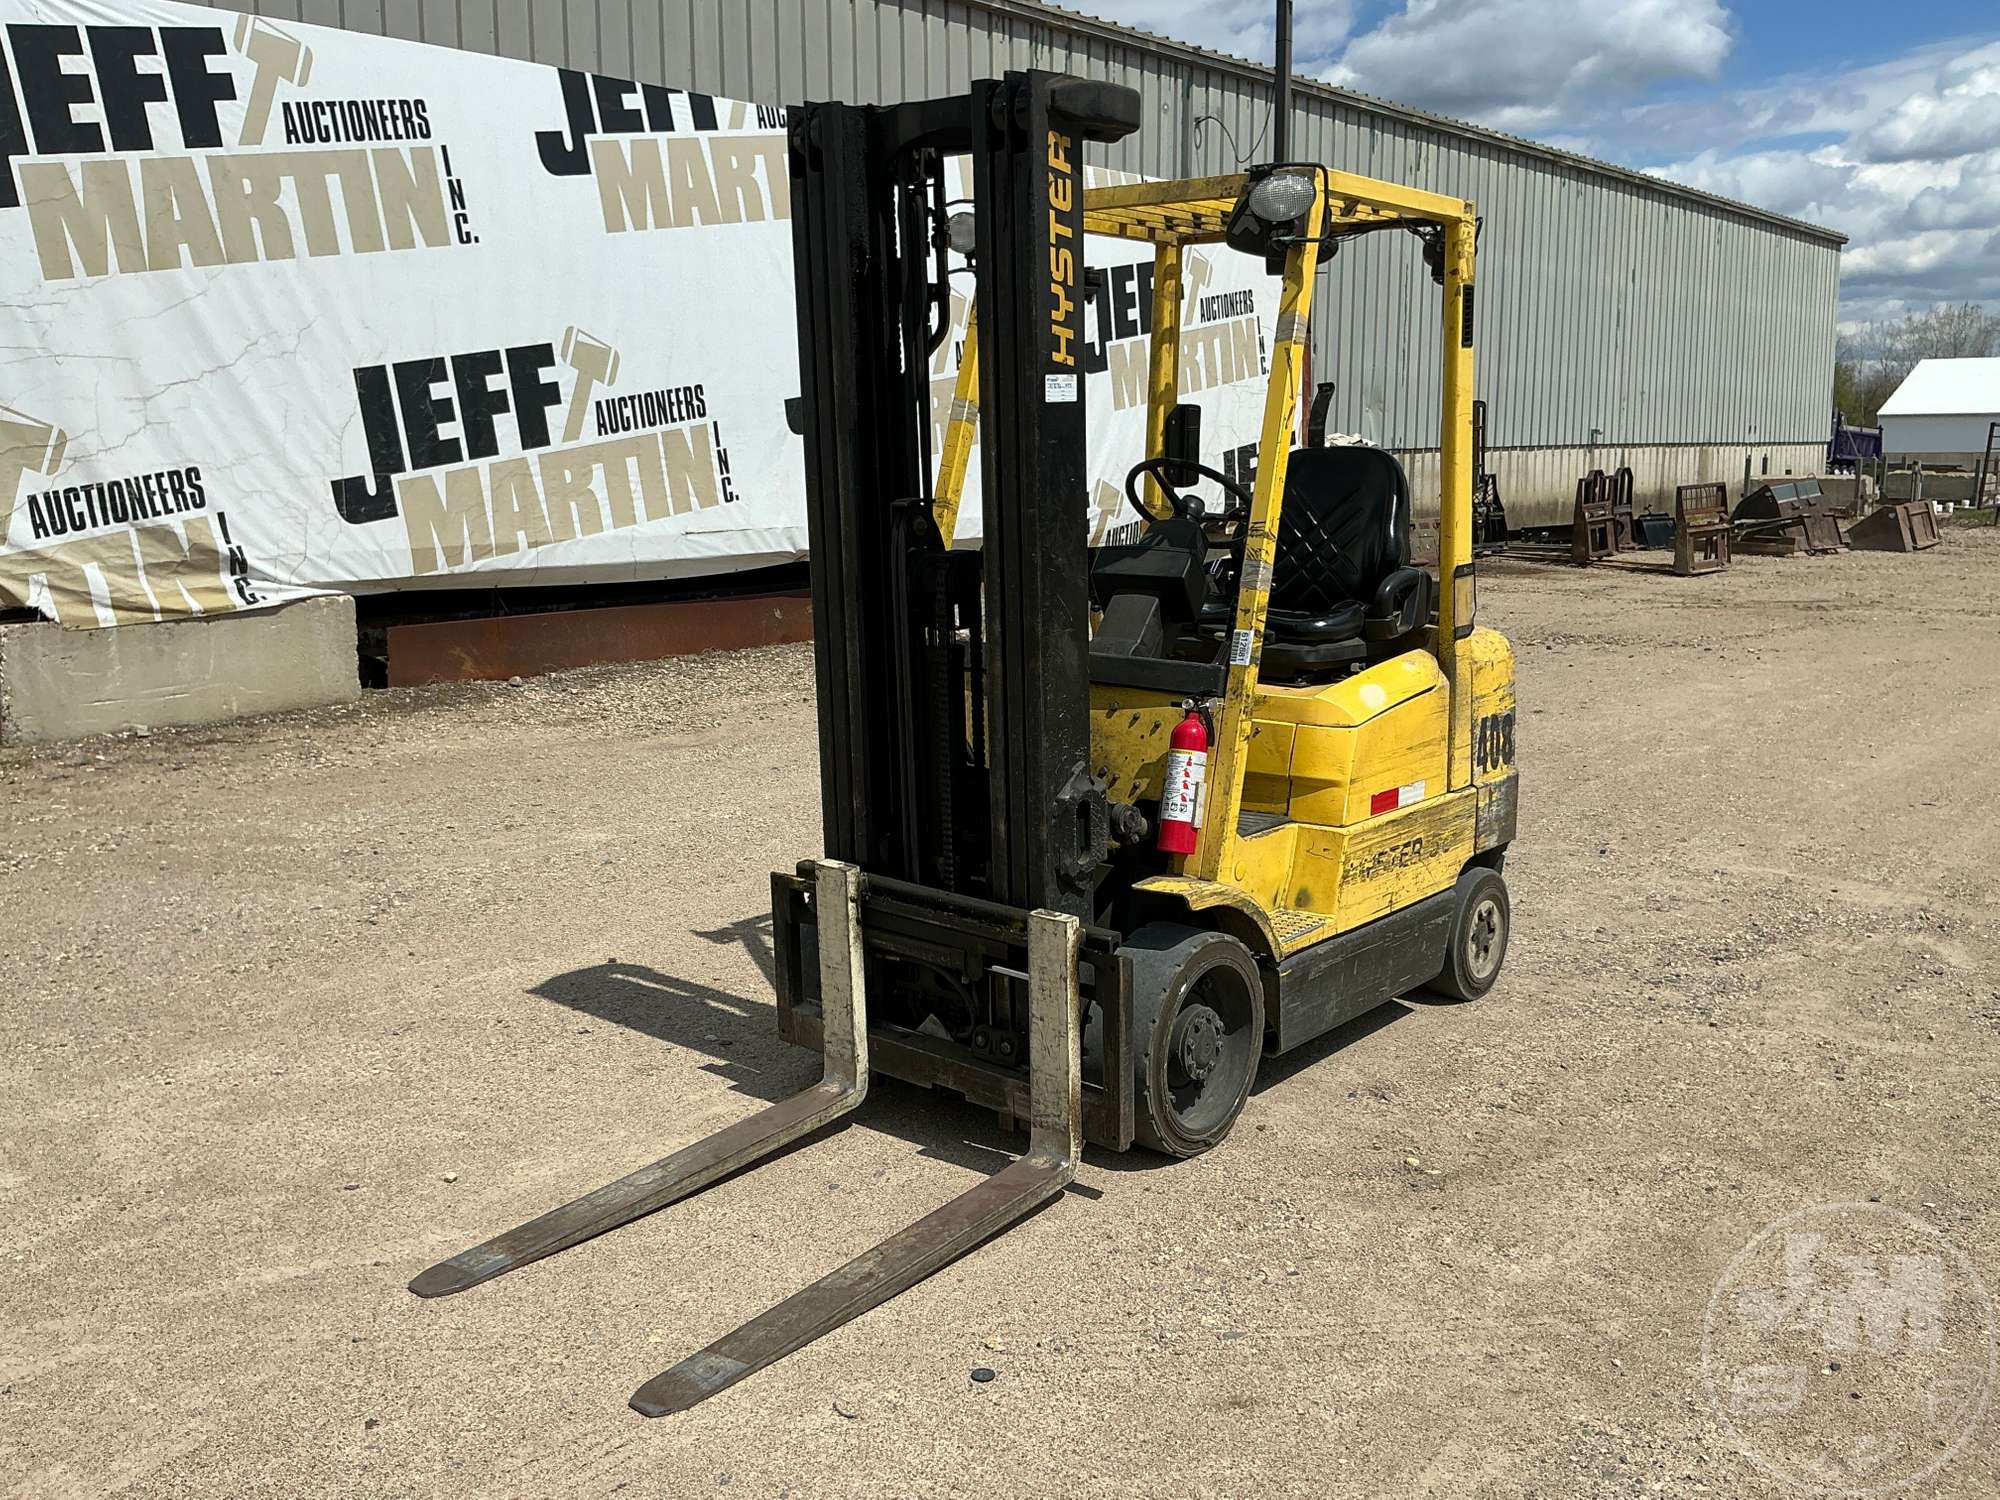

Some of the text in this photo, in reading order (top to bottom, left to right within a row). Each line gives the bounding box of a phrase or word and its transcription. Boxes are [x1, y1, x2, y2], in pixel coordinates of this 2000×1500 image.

[281, 99, 431, 144] AUCTIONEERS
[18, 146, 452, 281] MARTIN
[441, 144, 480, 245] INC.
[591, 136, 790, 234] MART
[1047, 130, 1075, 366] HYSTER
[1084, 261, 1155, 374] JEF
[1199, 289, 1254, 323] AUCTIONEERS
[595, 384, 707, 437] AUCTIONEERS
[1109, 318, 1259, 411] MRTIN
[331, 342, 562, 525] JEFF
[712, 420, 740, 503] INC.
[27, 466, 207, 539] AUCTIONEERS
[398, 423, 720, 576] MARTIN
